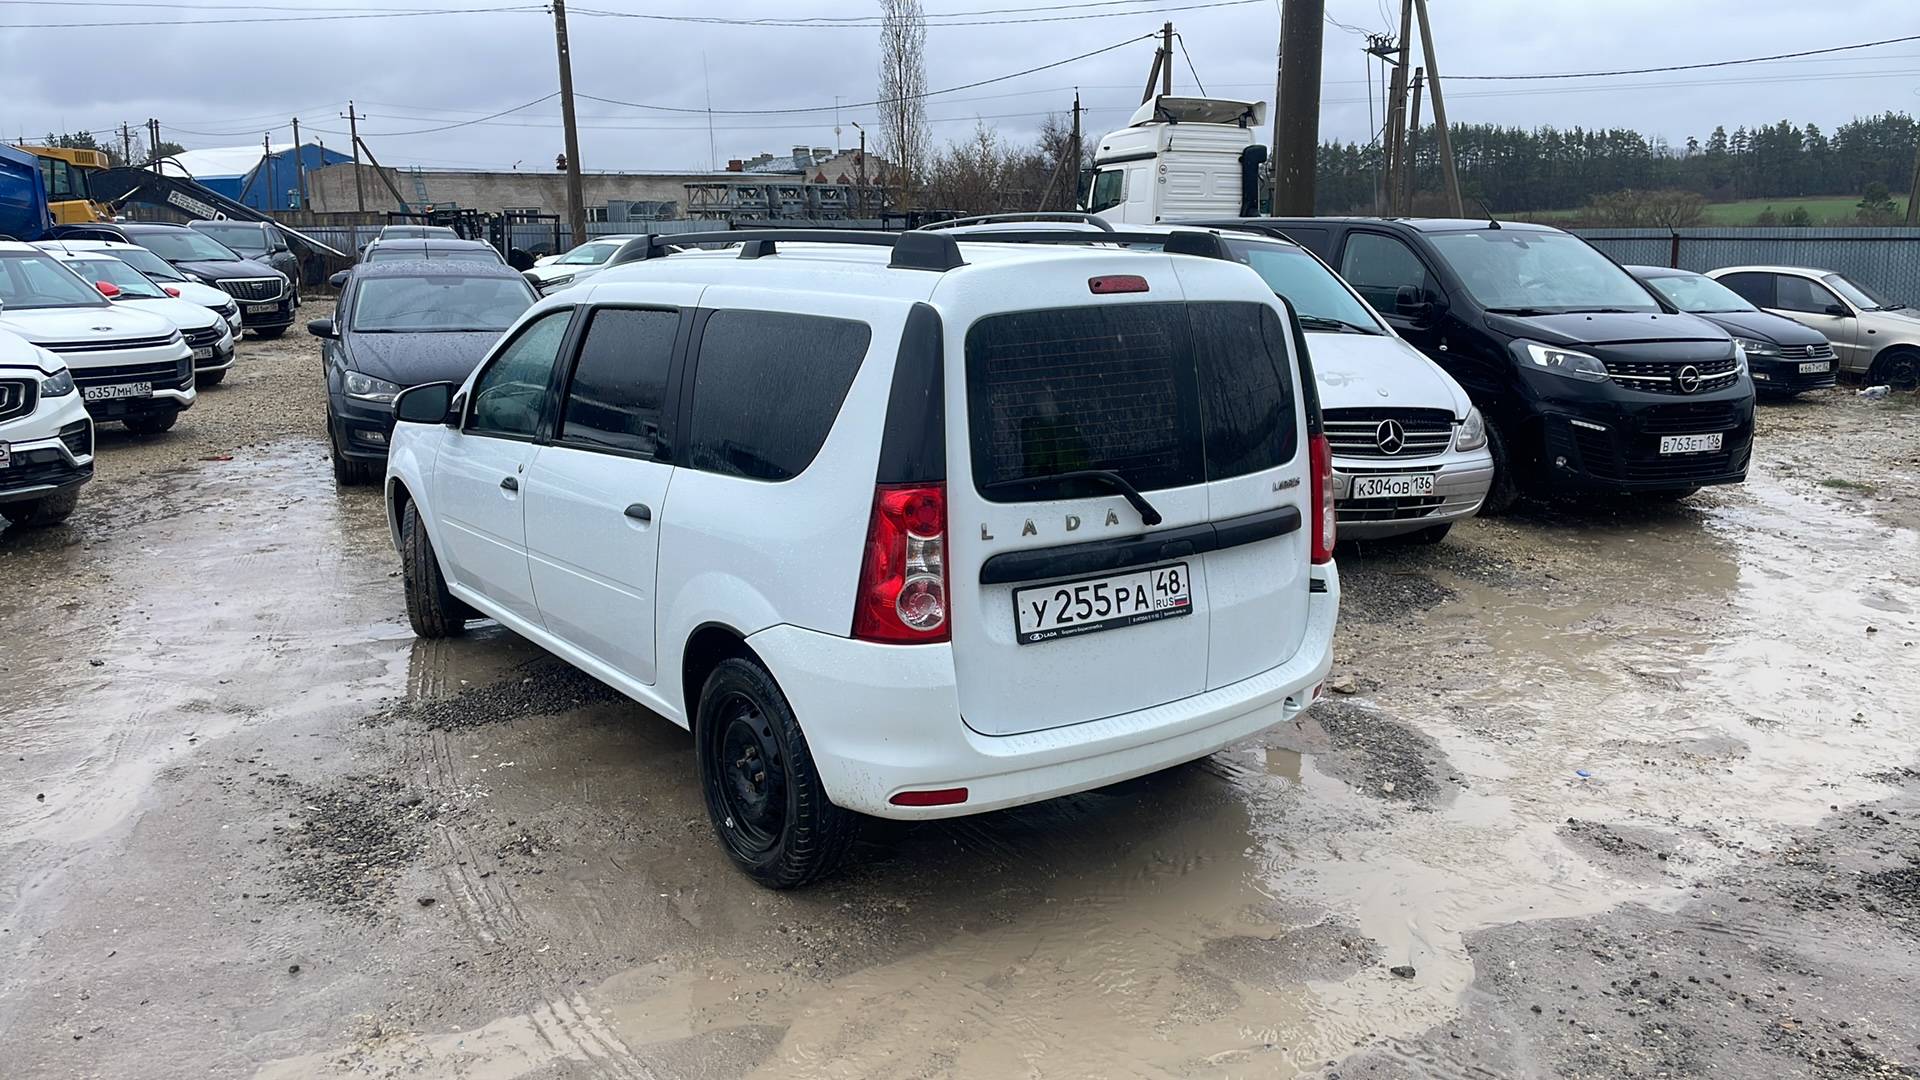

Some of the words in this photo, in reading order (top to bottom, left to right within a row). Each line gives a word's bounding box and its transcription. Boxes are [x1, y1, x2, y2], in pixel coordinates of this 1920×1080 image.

[88, 386, 132, 399] О357МН
[133, 383, 150, 392] 136
[1662, 437, 1703, 451] В763ЕТ
[1706, 434, 1721, 446] 136
[1359, 478, 1410, 496] К304ОВ
[1413, 477, 1432, 490] 136
[980, 508, 1119, 541] LADA
[1031, 582, 1150, 628] У255РА
[1156, 569, 1181, 597] 48
[1156, 597, 1175, 609] RUS
